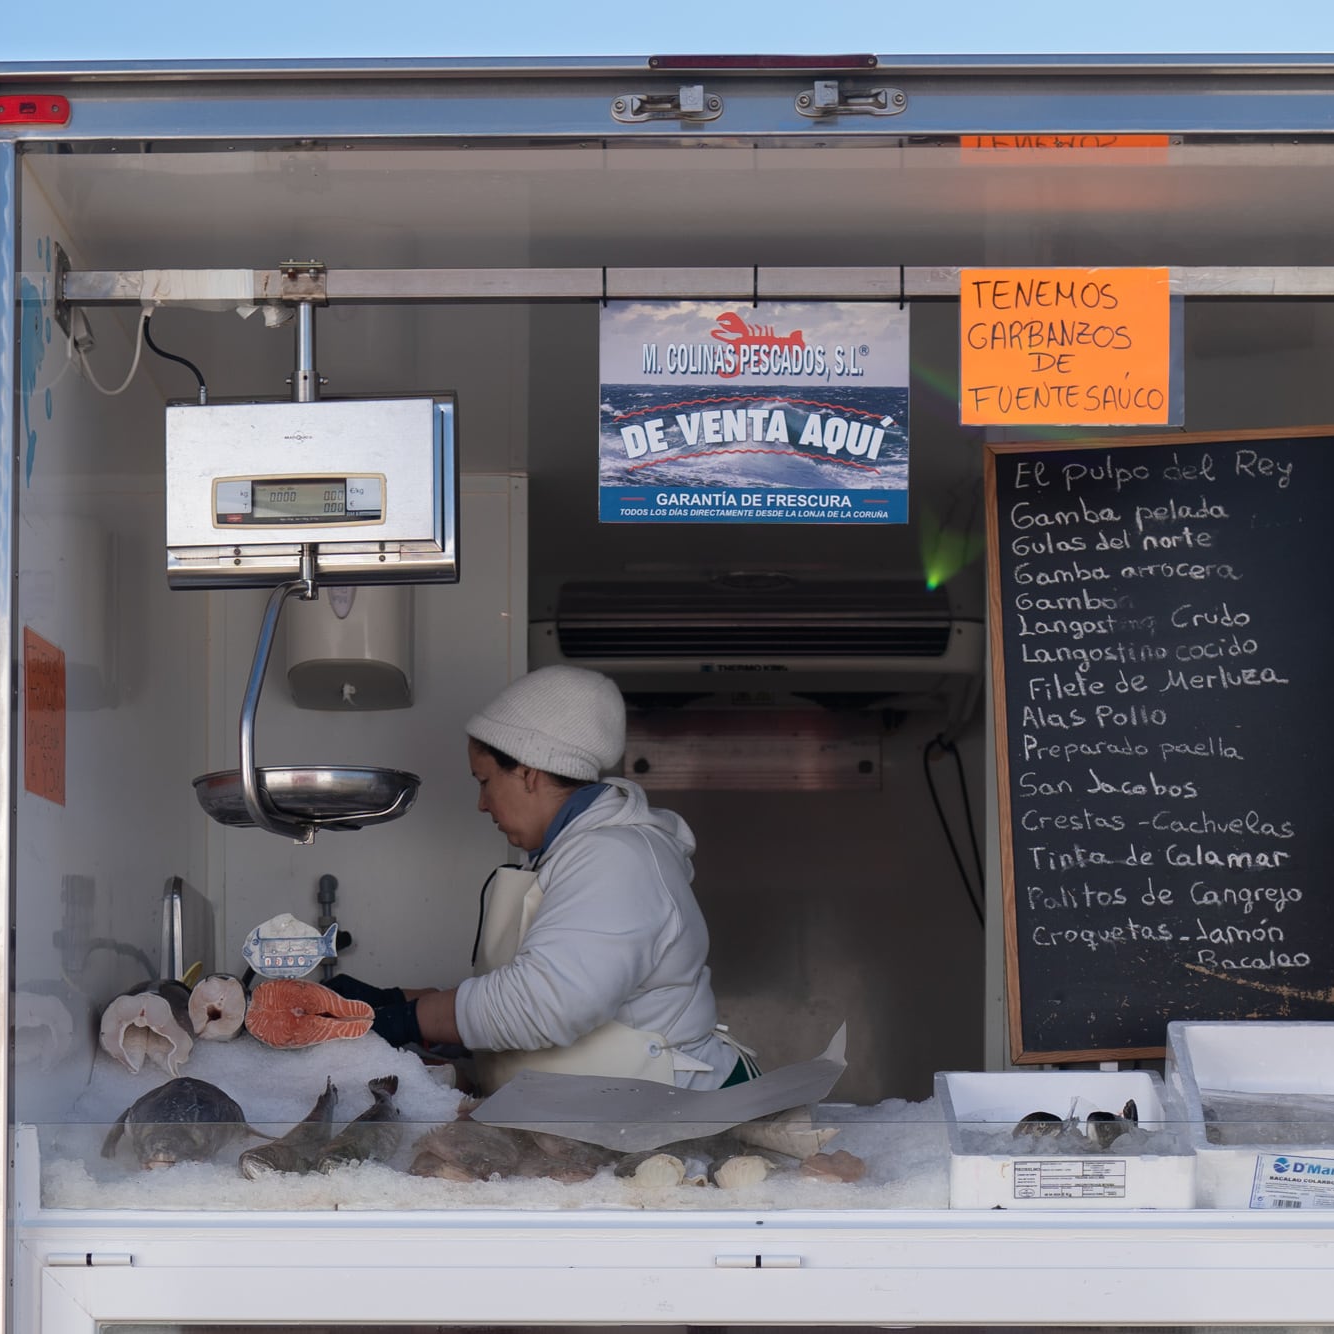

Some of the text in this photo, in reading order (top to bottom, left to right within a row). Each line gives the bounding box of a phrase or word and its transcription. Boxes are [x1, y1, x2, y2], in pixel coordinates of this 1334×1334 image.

[971, 280, 1119, 311] TENEMOS
[967, 321, 1132, 352] GARBANZOS
[642, 343, 662, 374] M.
[666, 343, 736, 375] COLINAS
[739, 344, 830, 382] PESCADOS,
[1031, 351, 1072, 375] DE
[968, 372, 1165, 413] FUENTESAÚCO
[620, 409, 894, 460] DE VENTA AQUÍ
[1062, 454, 1150, 493] pulpo
[1163, 452, 1216, 482] del
[1235, 449, 1294, 488] Rey
[620, 507, 889, 519] TODOS LOS DÍAS DIRECTAMENTE DESDE LA LONJA DE LA CORUÑA
[656, 491, 852, 508] GARANTÍA DE FRESCURA
[1010, 496, 1230, 534] Gamba pelada
[1011, 526, 1213, 557] Gulas del norte
[1014, 561, 1110, 585] Gamba
[1171, 602, 1251, 629] Crudo
[1022, 636, 1258, 673] Langostino cocido
[1028, 664, 1290, 701] Filete de Merluza
[1021, 704, 1167, 729] Alas Pollo
[1022, 734, 1244, 761] Preparado paella
[1019, 772, 1073, 798] San
[1021, 804, 1126, 832] Crestas
[1028, 844, 1291, 871] Tinta de Calamar
[1026, 878, 1303, 914] Palitos de Cangrejo
[1032, 918, 1173, 951] Croquetas
[1196, 918, 1285, 945] Jamón
[1197, 950, 1311, 970] Bacalao
